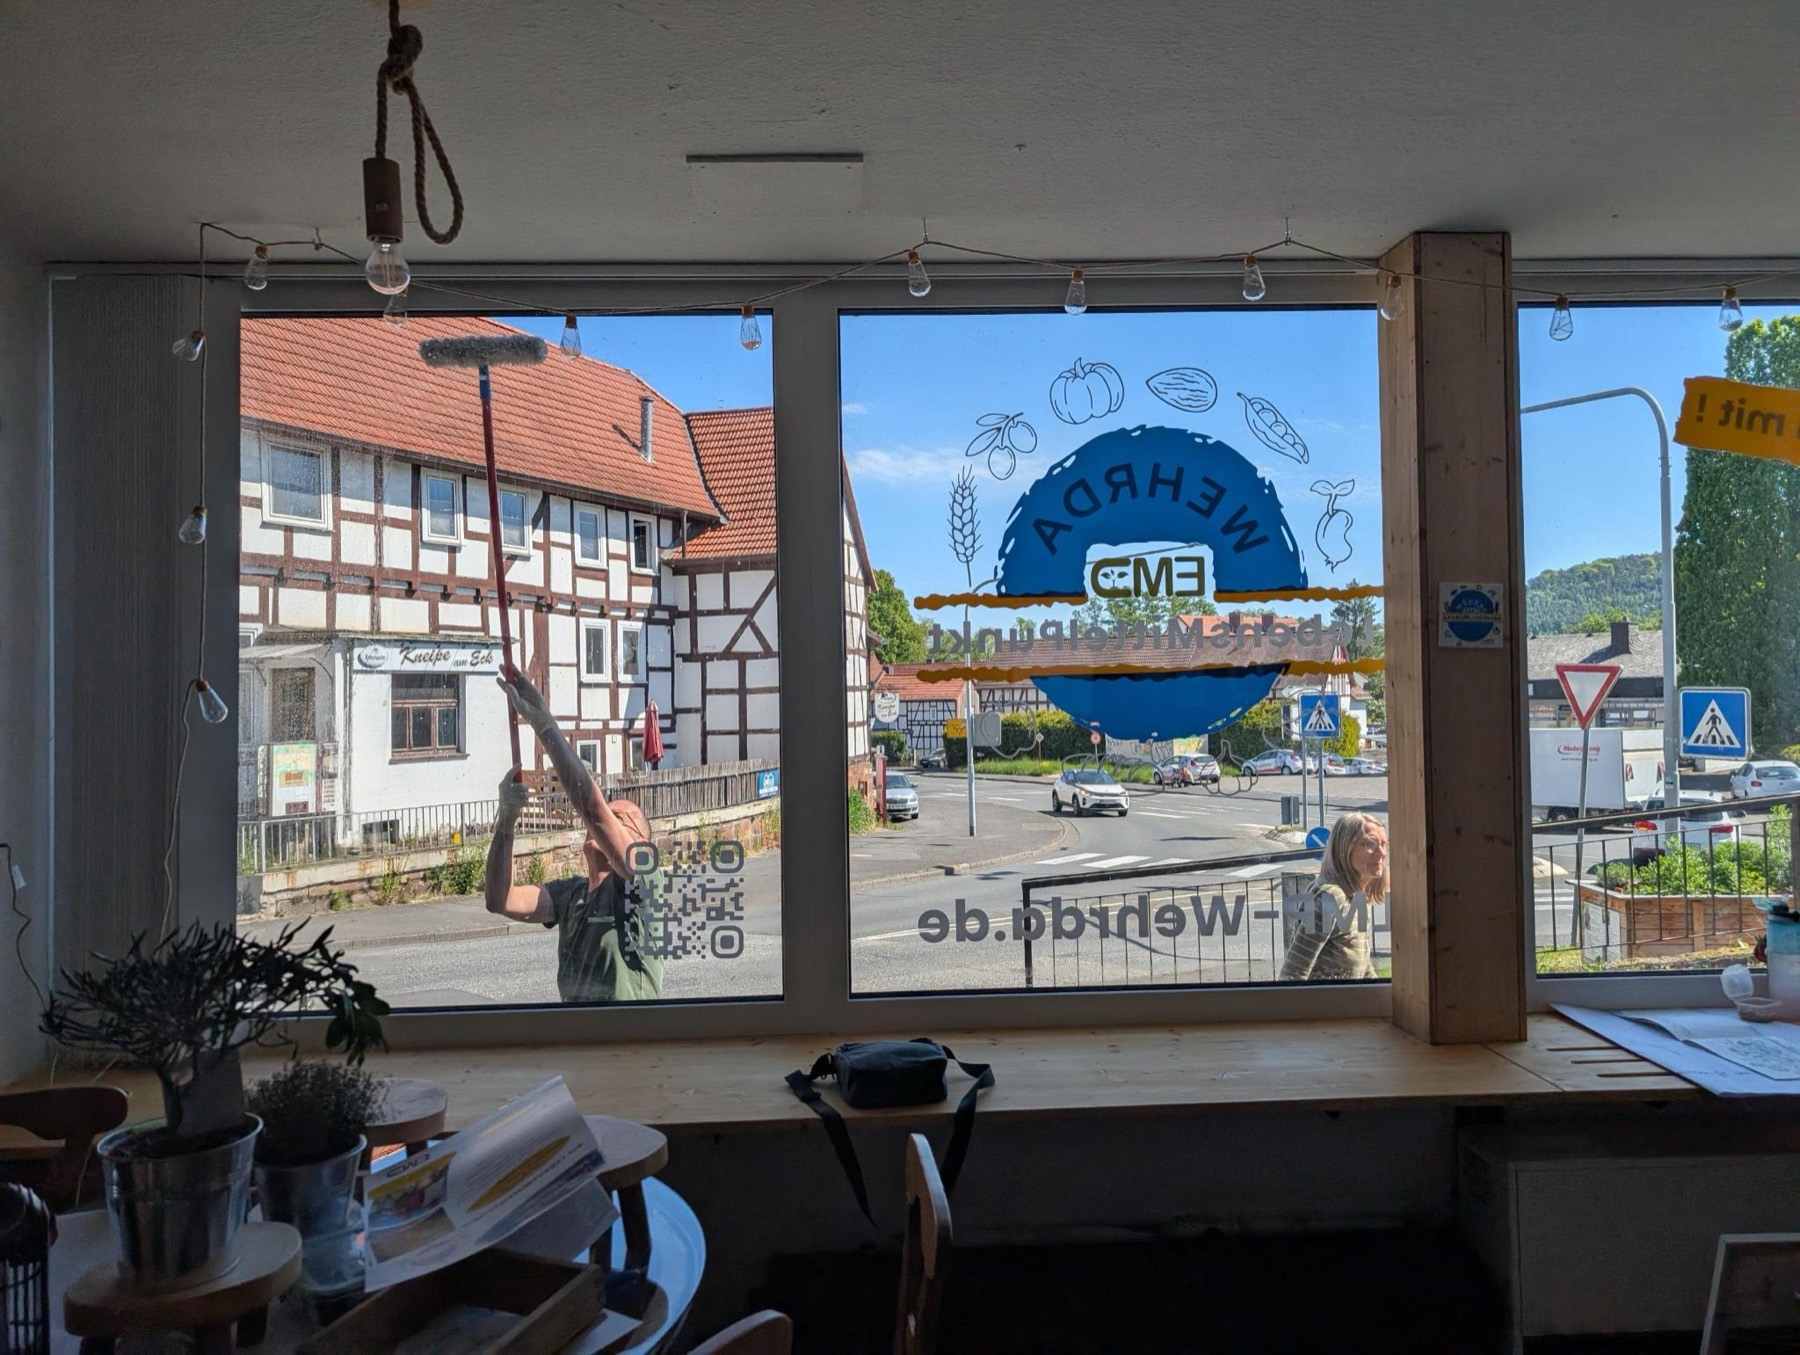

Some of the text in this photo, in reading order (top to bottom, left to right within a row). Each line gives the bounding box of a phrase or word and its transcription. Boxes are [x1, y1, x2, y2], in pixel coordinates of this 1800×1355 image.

[399, 646, 450, 666] Kneipe
[453, 659, 468, 667] am
[469, 649, 494, 666] Eck
